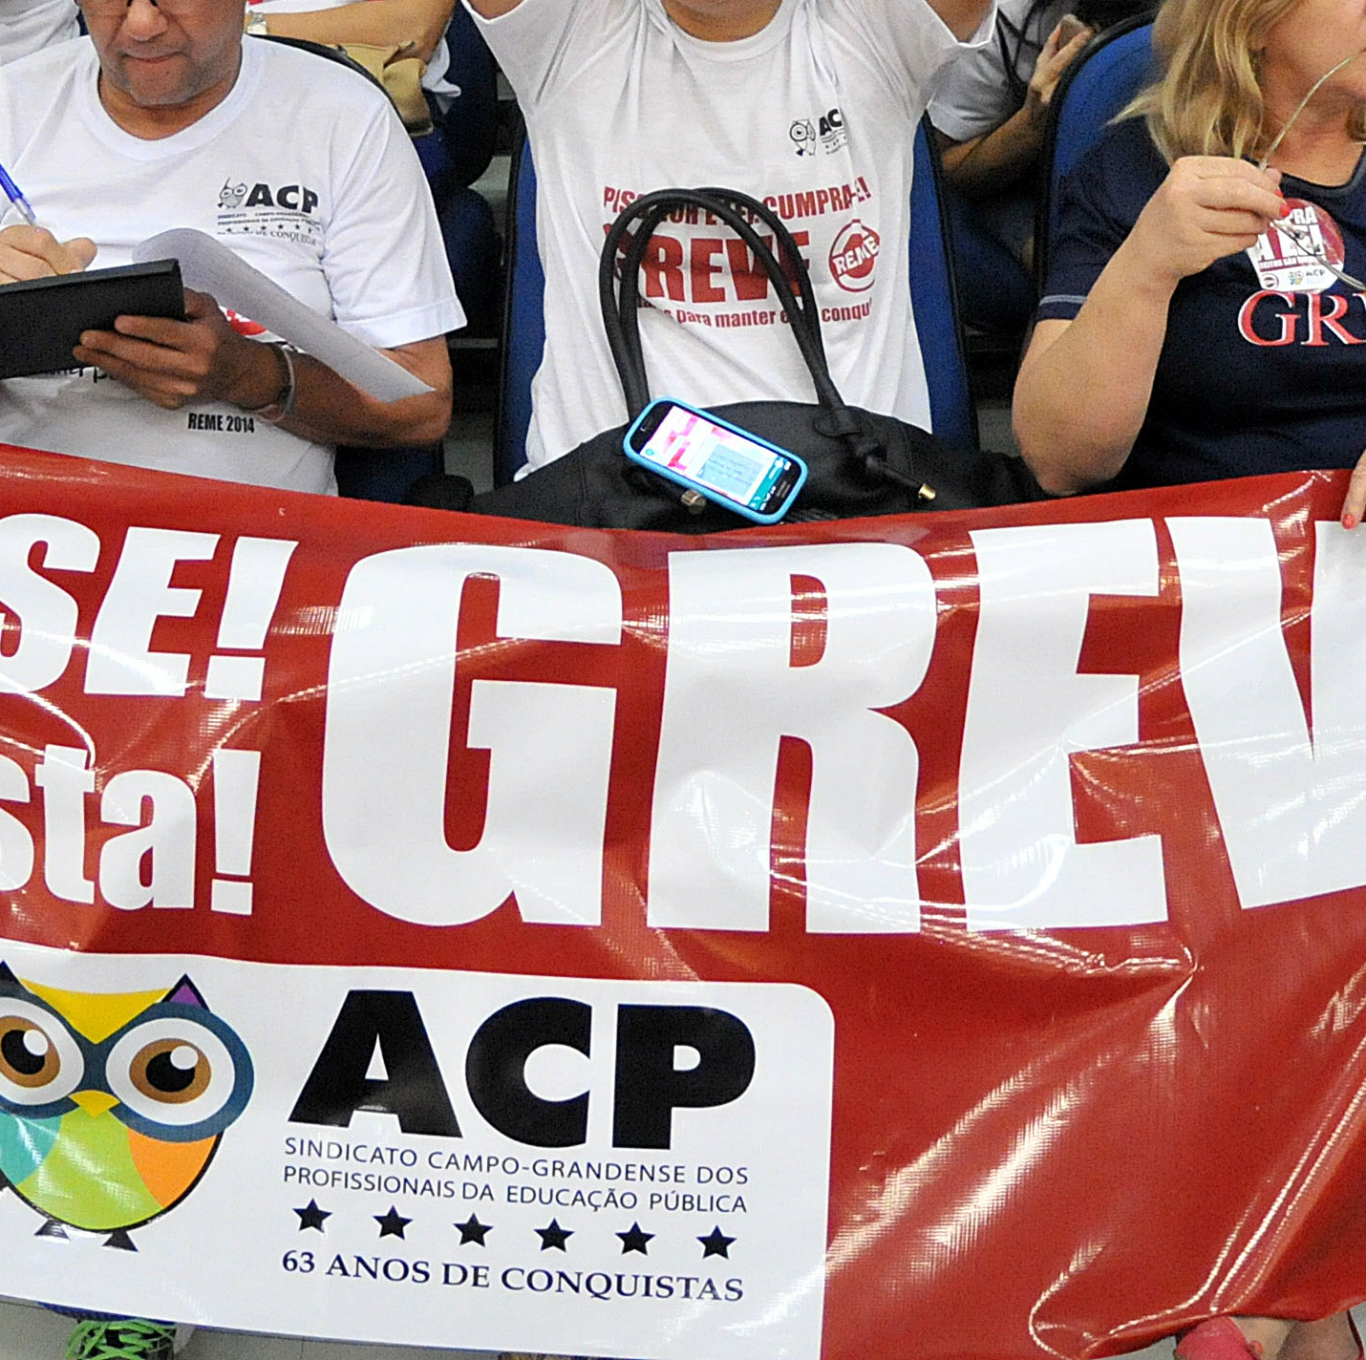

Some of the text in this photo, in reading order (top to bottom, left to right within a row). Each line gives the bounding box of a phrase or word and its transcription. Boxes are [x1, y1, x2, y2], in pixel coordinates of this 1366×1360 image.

[819, 109, 842, 136] AC
[245, 183, 319, 214] ACP
[832, 232, 880, 277] REME
[715, 309, 776, 328] manter
[188, 412, 255, 433] REME 2014
[288, 989, 756, 1150] ACP
[284, 1136, 749, 1185] SINDICATO CAMPO-GRANDENSE DOS
[283, 1165, 748, 1215] PROFISSIONAIS DA EDUCAÇÃO PÚBLICA
[281, 1249, 746, 1303] 63 ANOS DE CONQUISTAS
